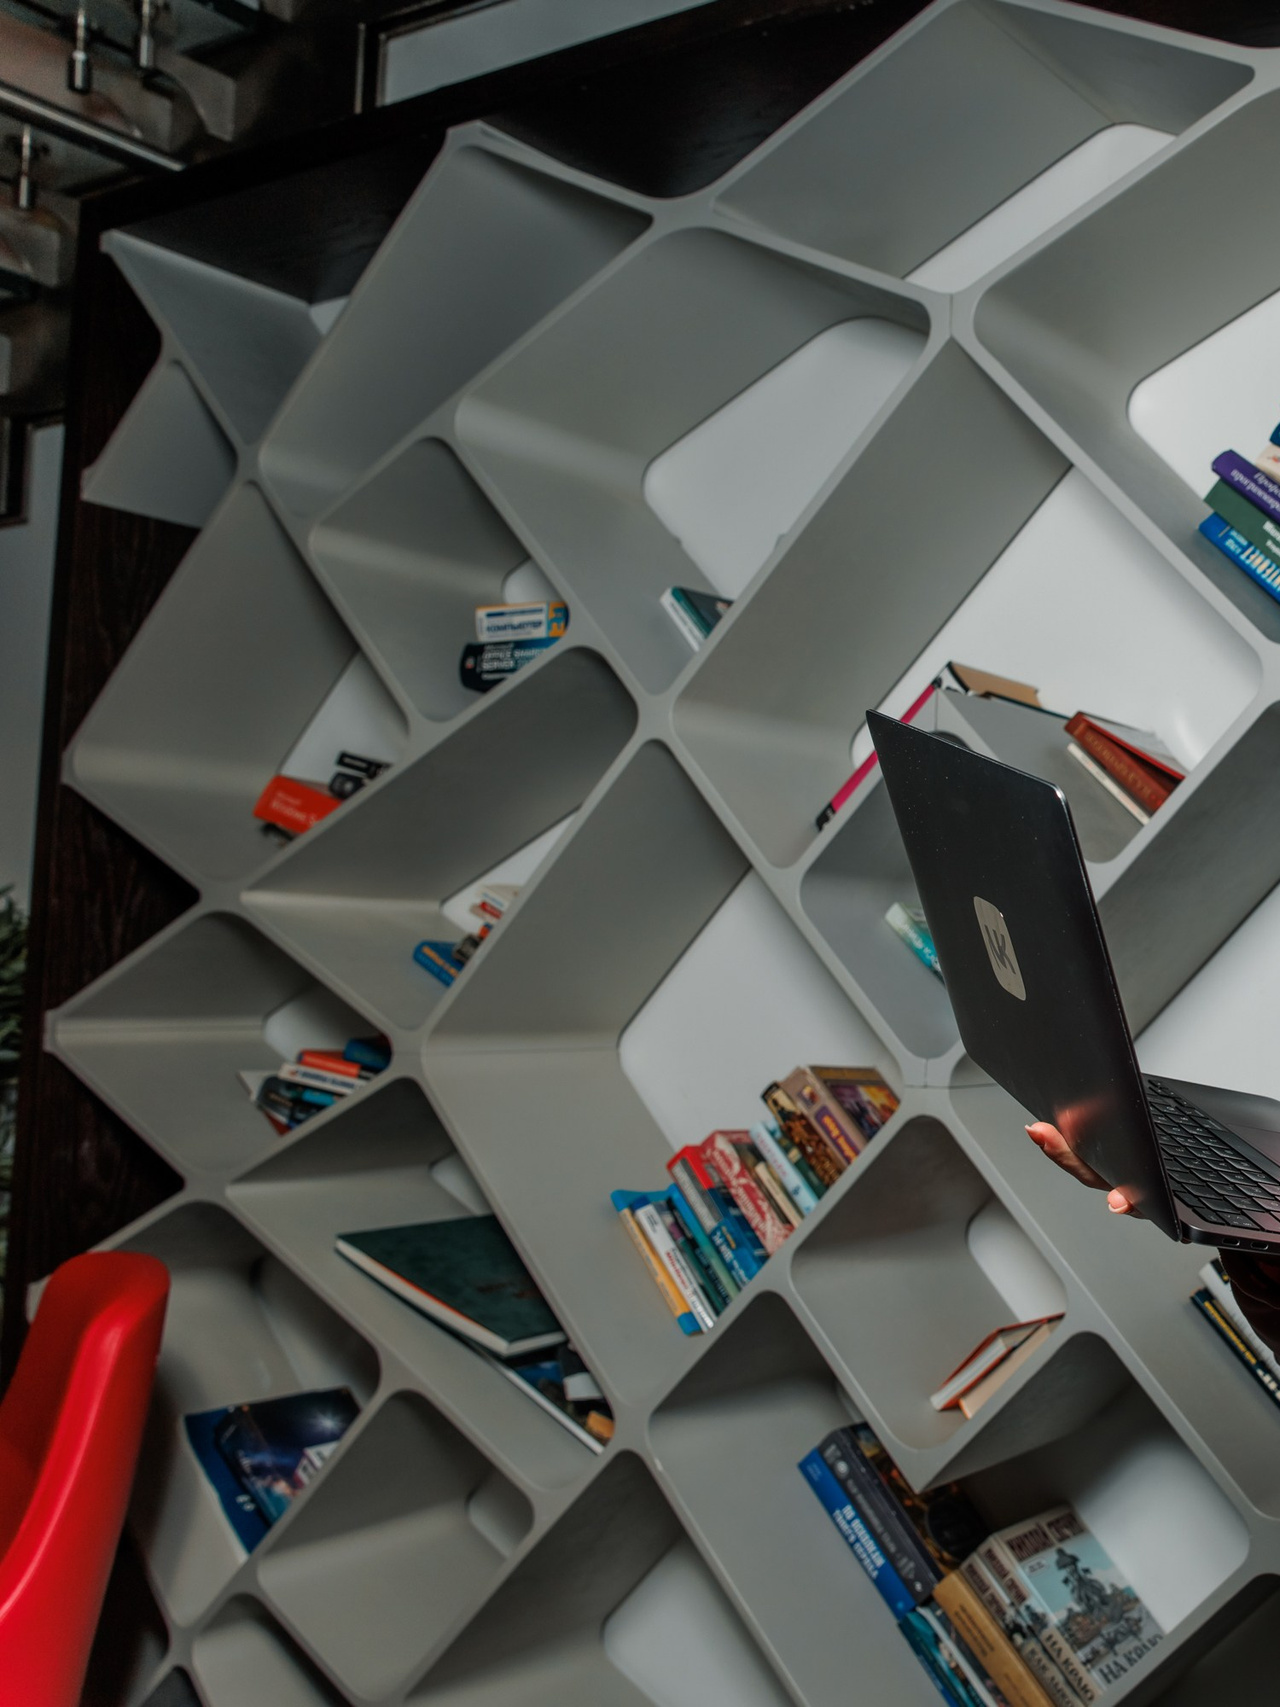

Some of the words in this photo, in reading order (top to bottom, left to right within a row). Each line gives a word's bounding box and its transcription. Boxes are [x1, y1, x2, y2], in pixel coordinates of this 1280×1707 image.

[1043, 1633, 1064, 1657] НА
[1059, 1655, 1097, 1703] КРАЮ
[1099, 1658, 1128, 1684] НА
